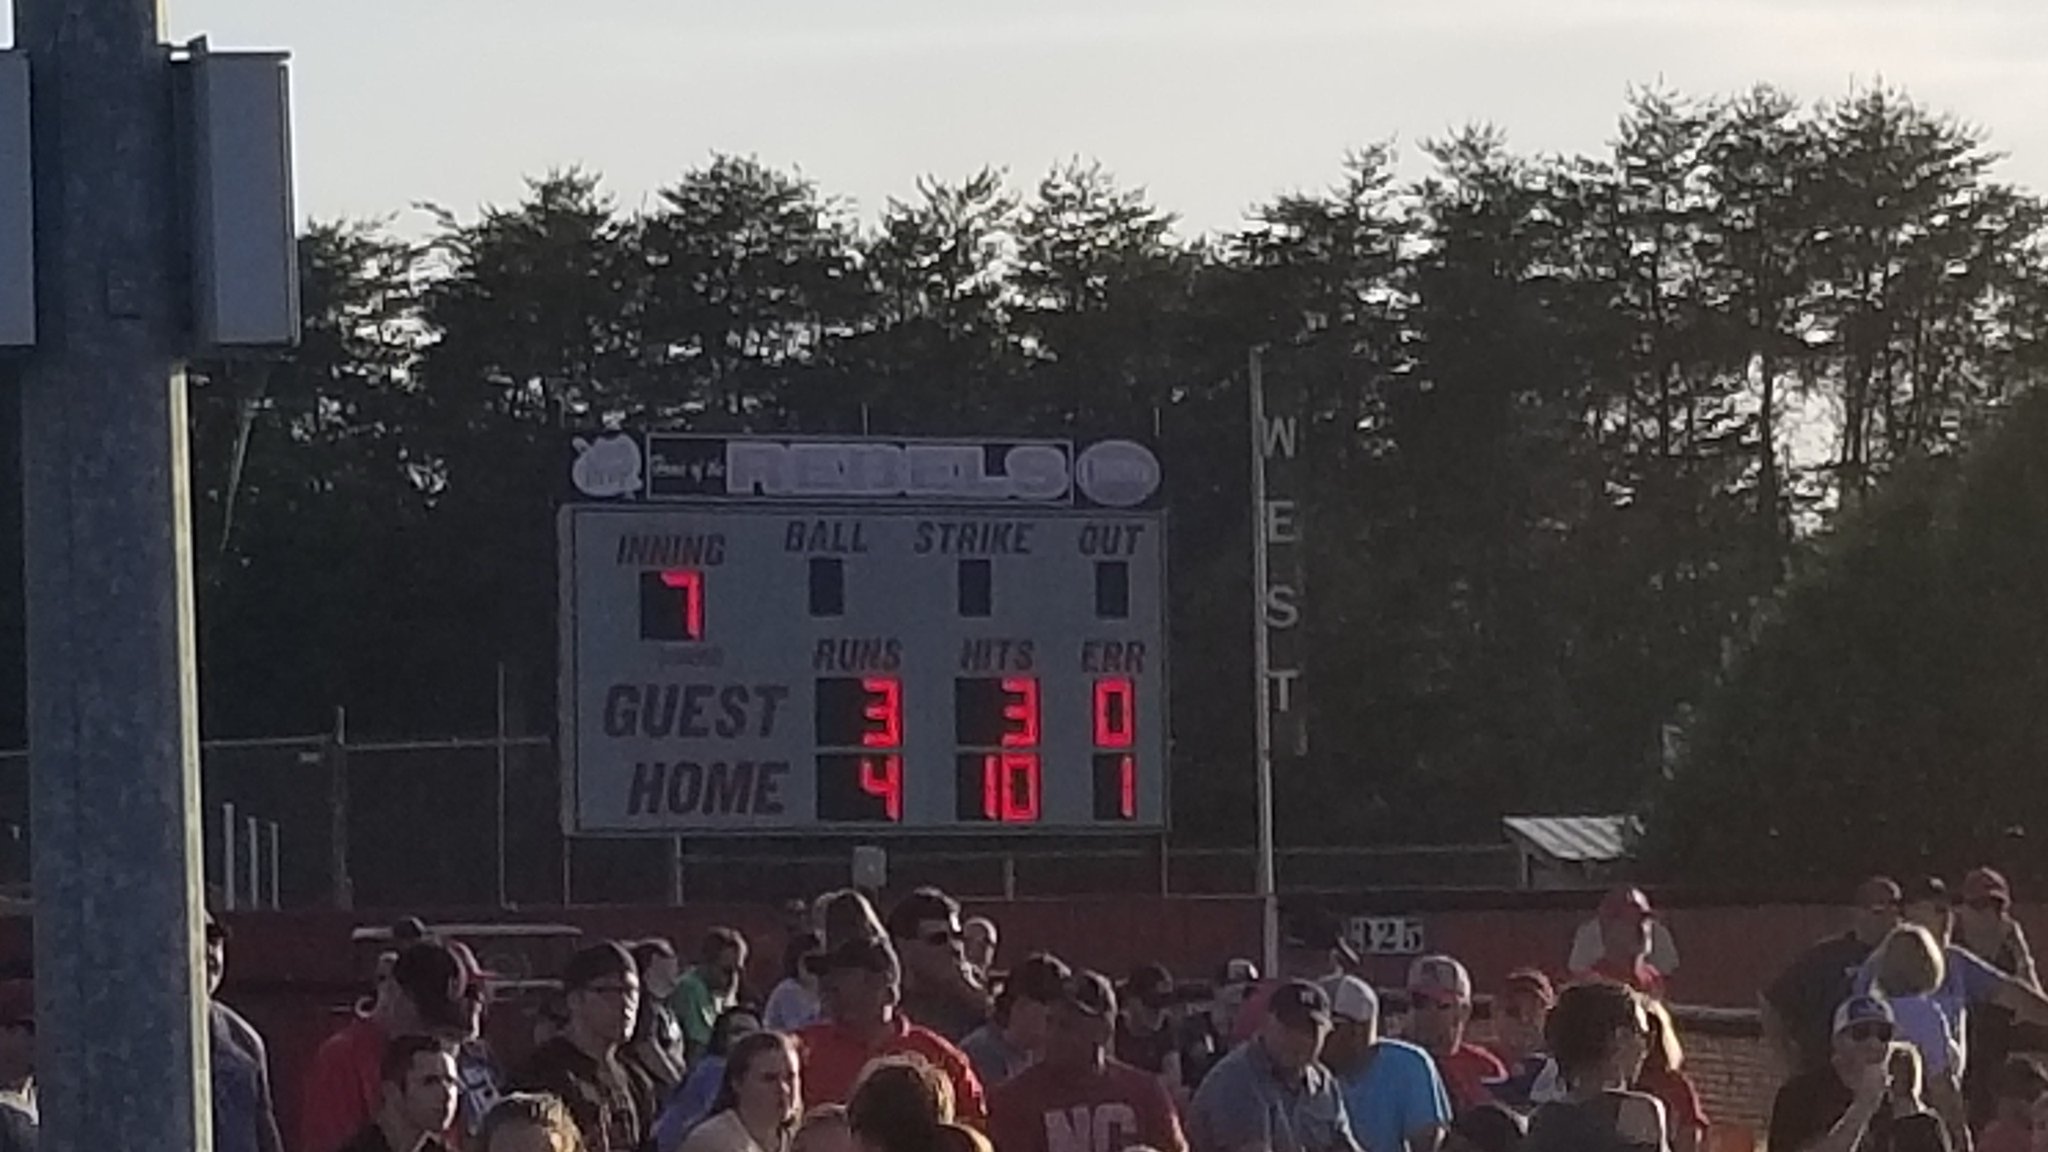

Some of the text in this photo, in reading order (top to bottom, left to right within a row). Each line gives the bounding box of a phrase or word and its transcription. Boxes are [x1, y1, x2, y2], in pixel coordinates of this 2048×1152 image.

[727, 442, 1067, 499] REBELS
[617, 534, 725, 566] INNING
[785, 521, 869, 554] BALL
[914, 521, 1034, 555] STRIKE
[1079, 524, 1145, 555] OUT
[1264, 417, 1299, 712] WEST
[661, 570, 702, 638] 7
[813, 638, 902, 671] RUNS
[960, 638, 1035, 671] HITS
[1081, 642, 1146, 674] ERR
[604, 683, 789, 738] GUEST
[862, 678, 901, 748] 3
[1000, 678, 1040, 748] 3
[1094, 679, 1135, 747] 0
[627, 761, 790, 816] HOME
[858, 753, 901, 822] 4
[982, 755, 1040, 822] 10
[1121, 755, 1134, 820] 1
[1351, 920, 1421, 951] 325
